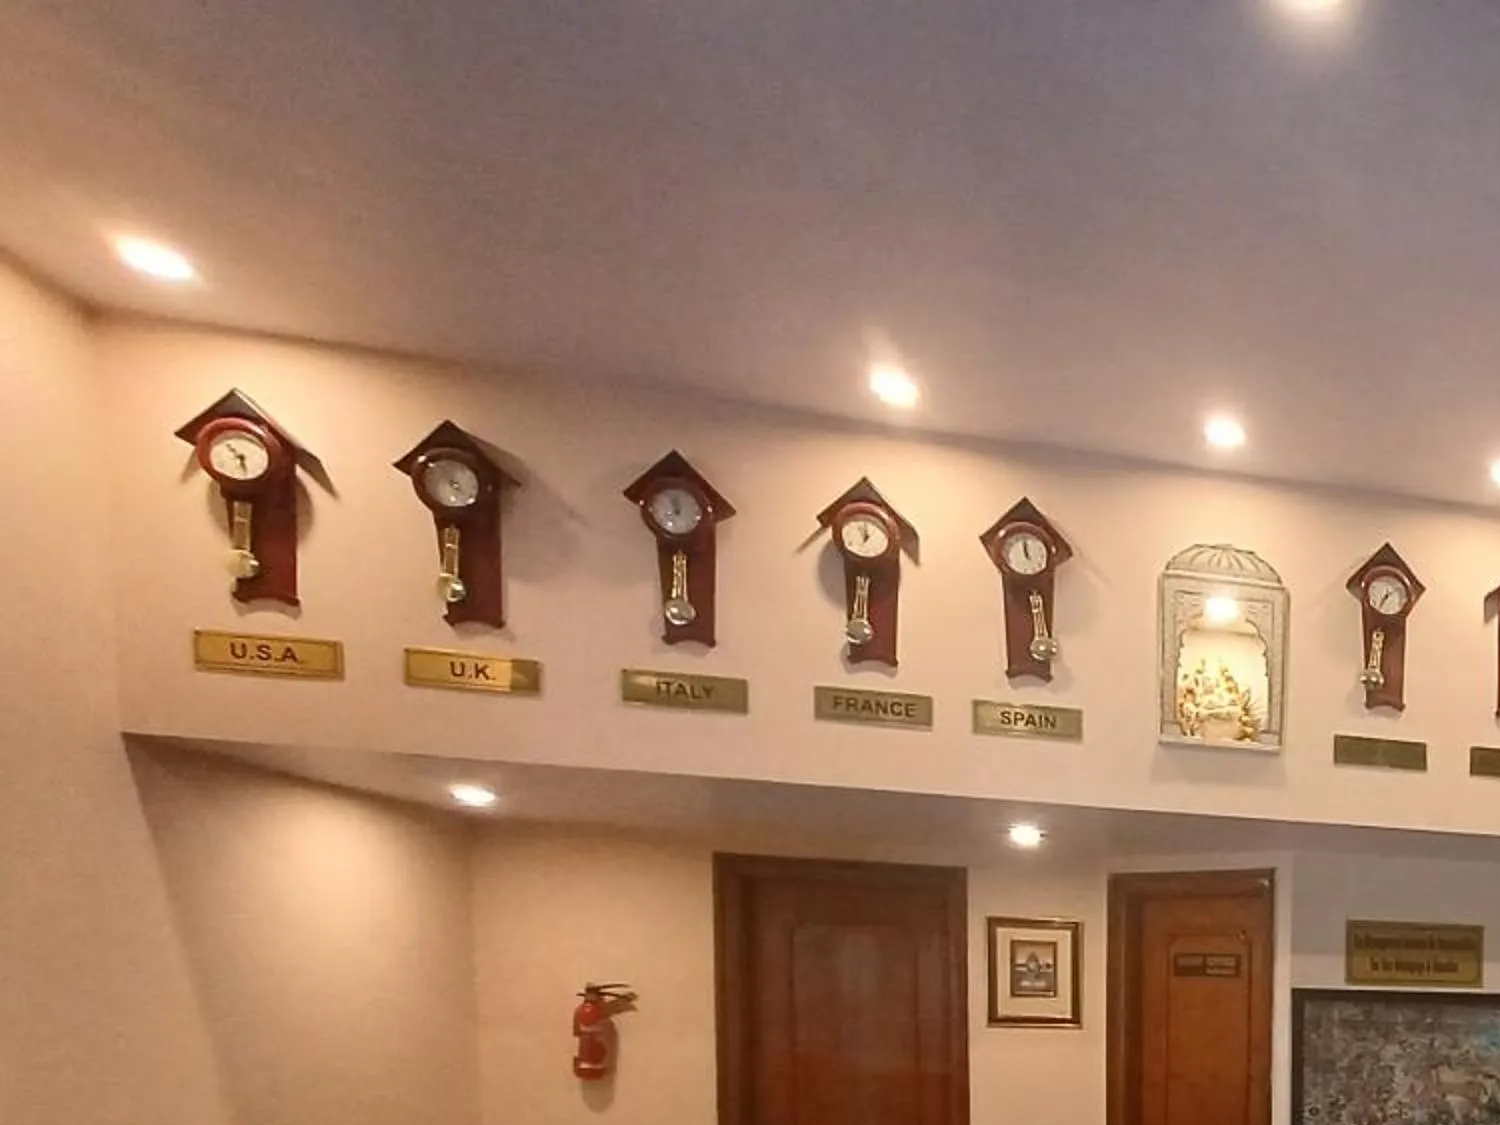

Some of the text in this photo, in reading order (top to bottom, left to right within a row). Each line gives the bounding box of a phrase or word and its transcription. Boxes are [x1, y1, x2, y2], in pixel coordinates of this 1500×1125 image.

[450, 660, 497, 681] U.K.
[655, 679, 715, 700] ITALY
[832, 695, 918, 718] FRANCE
[999, 709, 1058, 730] SPAIN
